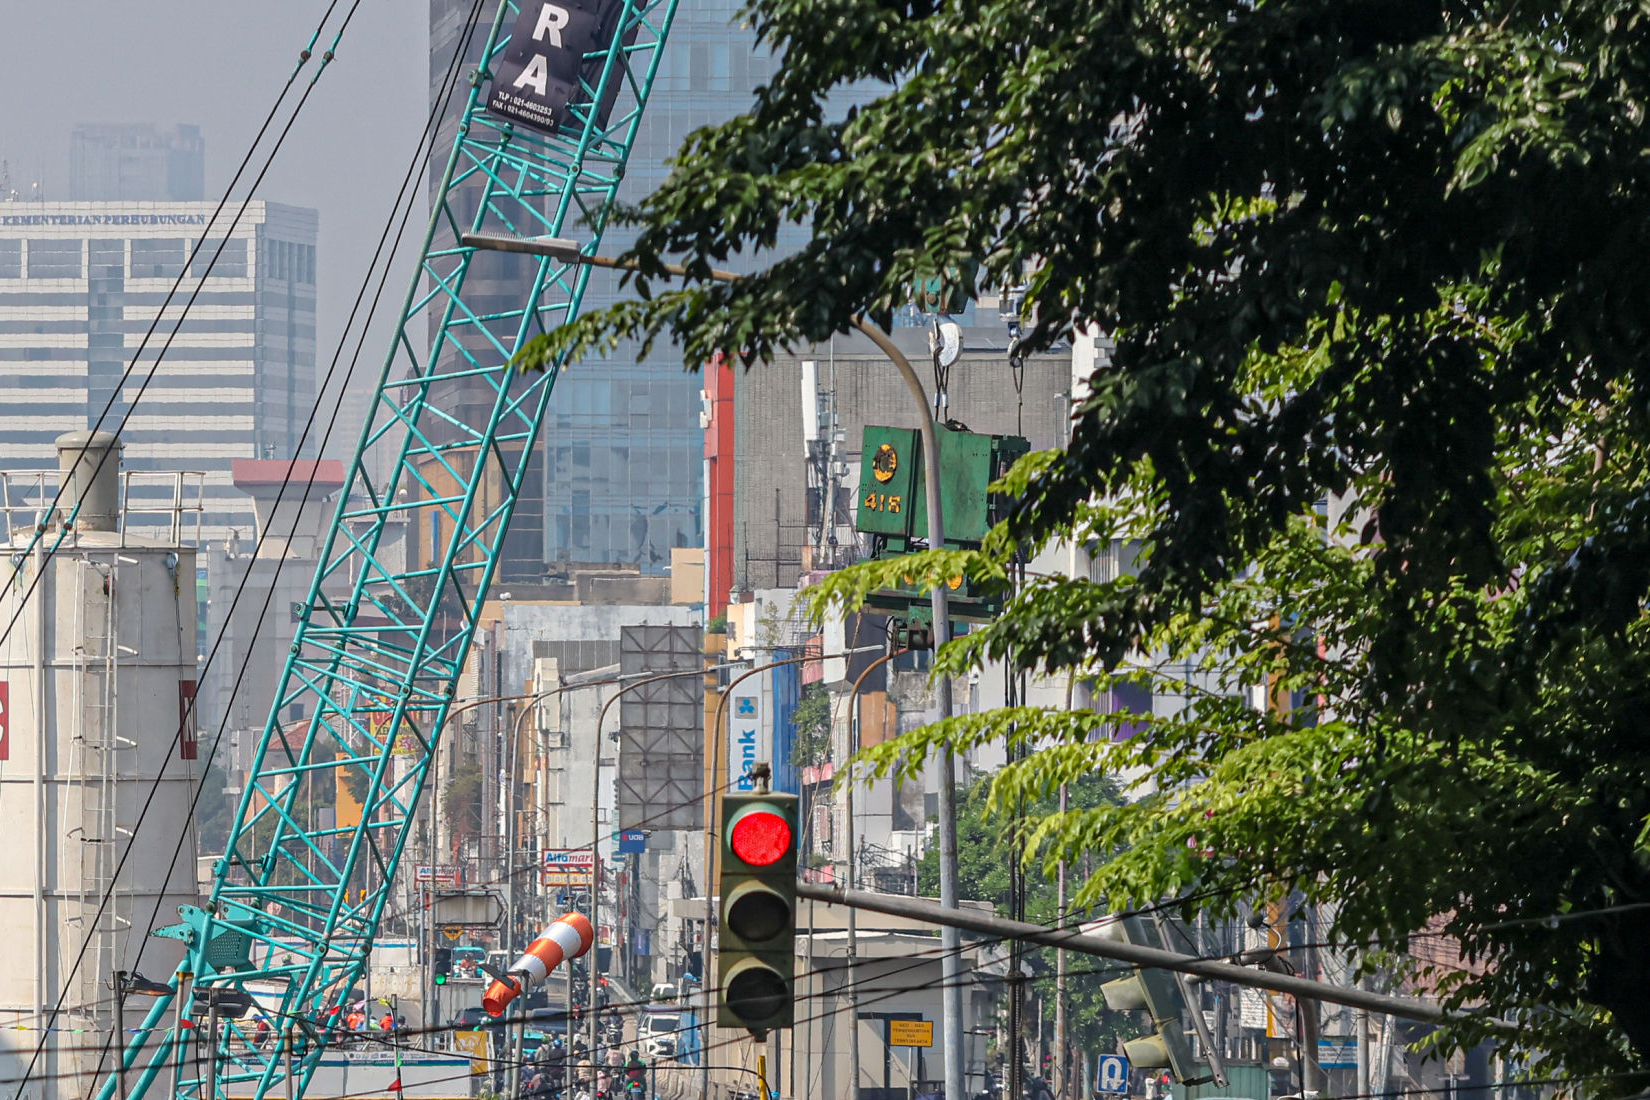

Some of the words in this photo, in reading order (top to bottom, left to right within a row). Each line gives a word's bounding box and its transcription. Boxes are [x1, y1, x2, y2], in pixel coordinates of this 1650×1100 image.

[2, 214, 101, 226] KEMENTERIAN
[104, 214, 205, 226] PERHUBUNGAN
[738, 729, 756, 791] Bank
